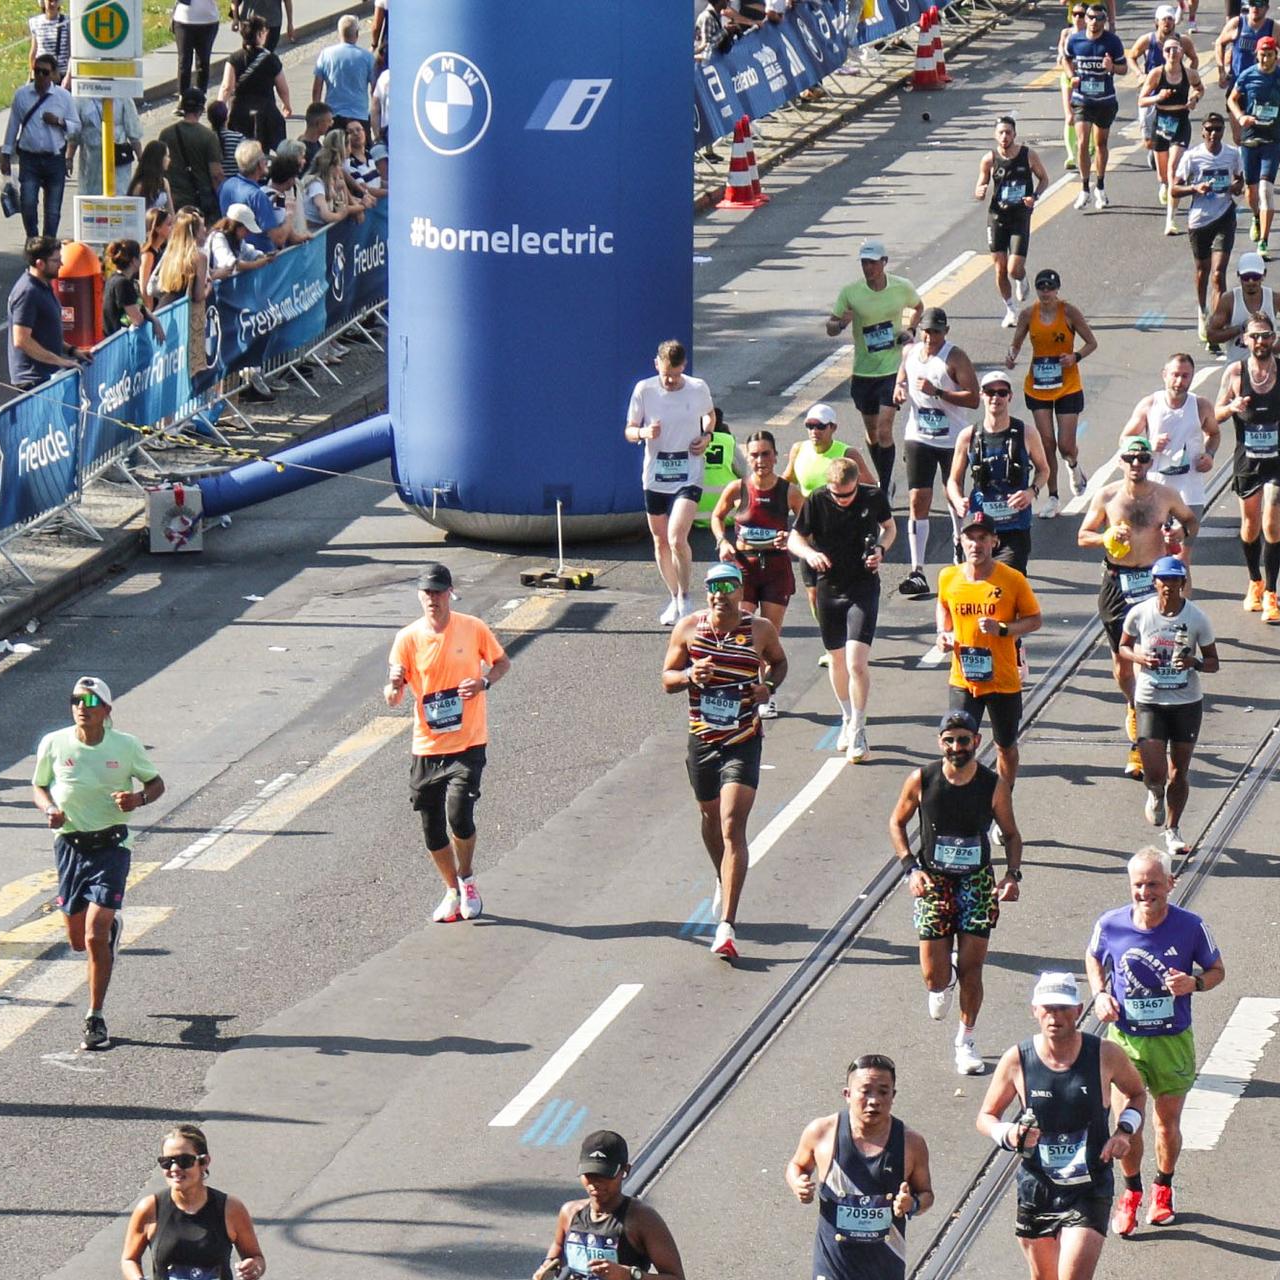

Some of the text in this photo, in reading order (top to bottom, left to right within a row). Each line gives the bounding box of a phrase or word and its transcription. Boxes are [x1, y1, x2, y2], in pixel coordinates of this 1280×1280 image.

[95, 12, 115, 38] H
[410, 217, 614, 254] #bornelectric
[353, 234, 385, 277] Freude
[98, 369, 131, 418] Freude
[152, 344, 186, 392] Fahren
[18, 425, 69, 476] Freude
[955, 602, 997, 617] FERIATO
[944, 848, 974, 857] 57876
[1132, 999, 1164, 1010] 83467
[846, 1208, 884, 1220] 70996
